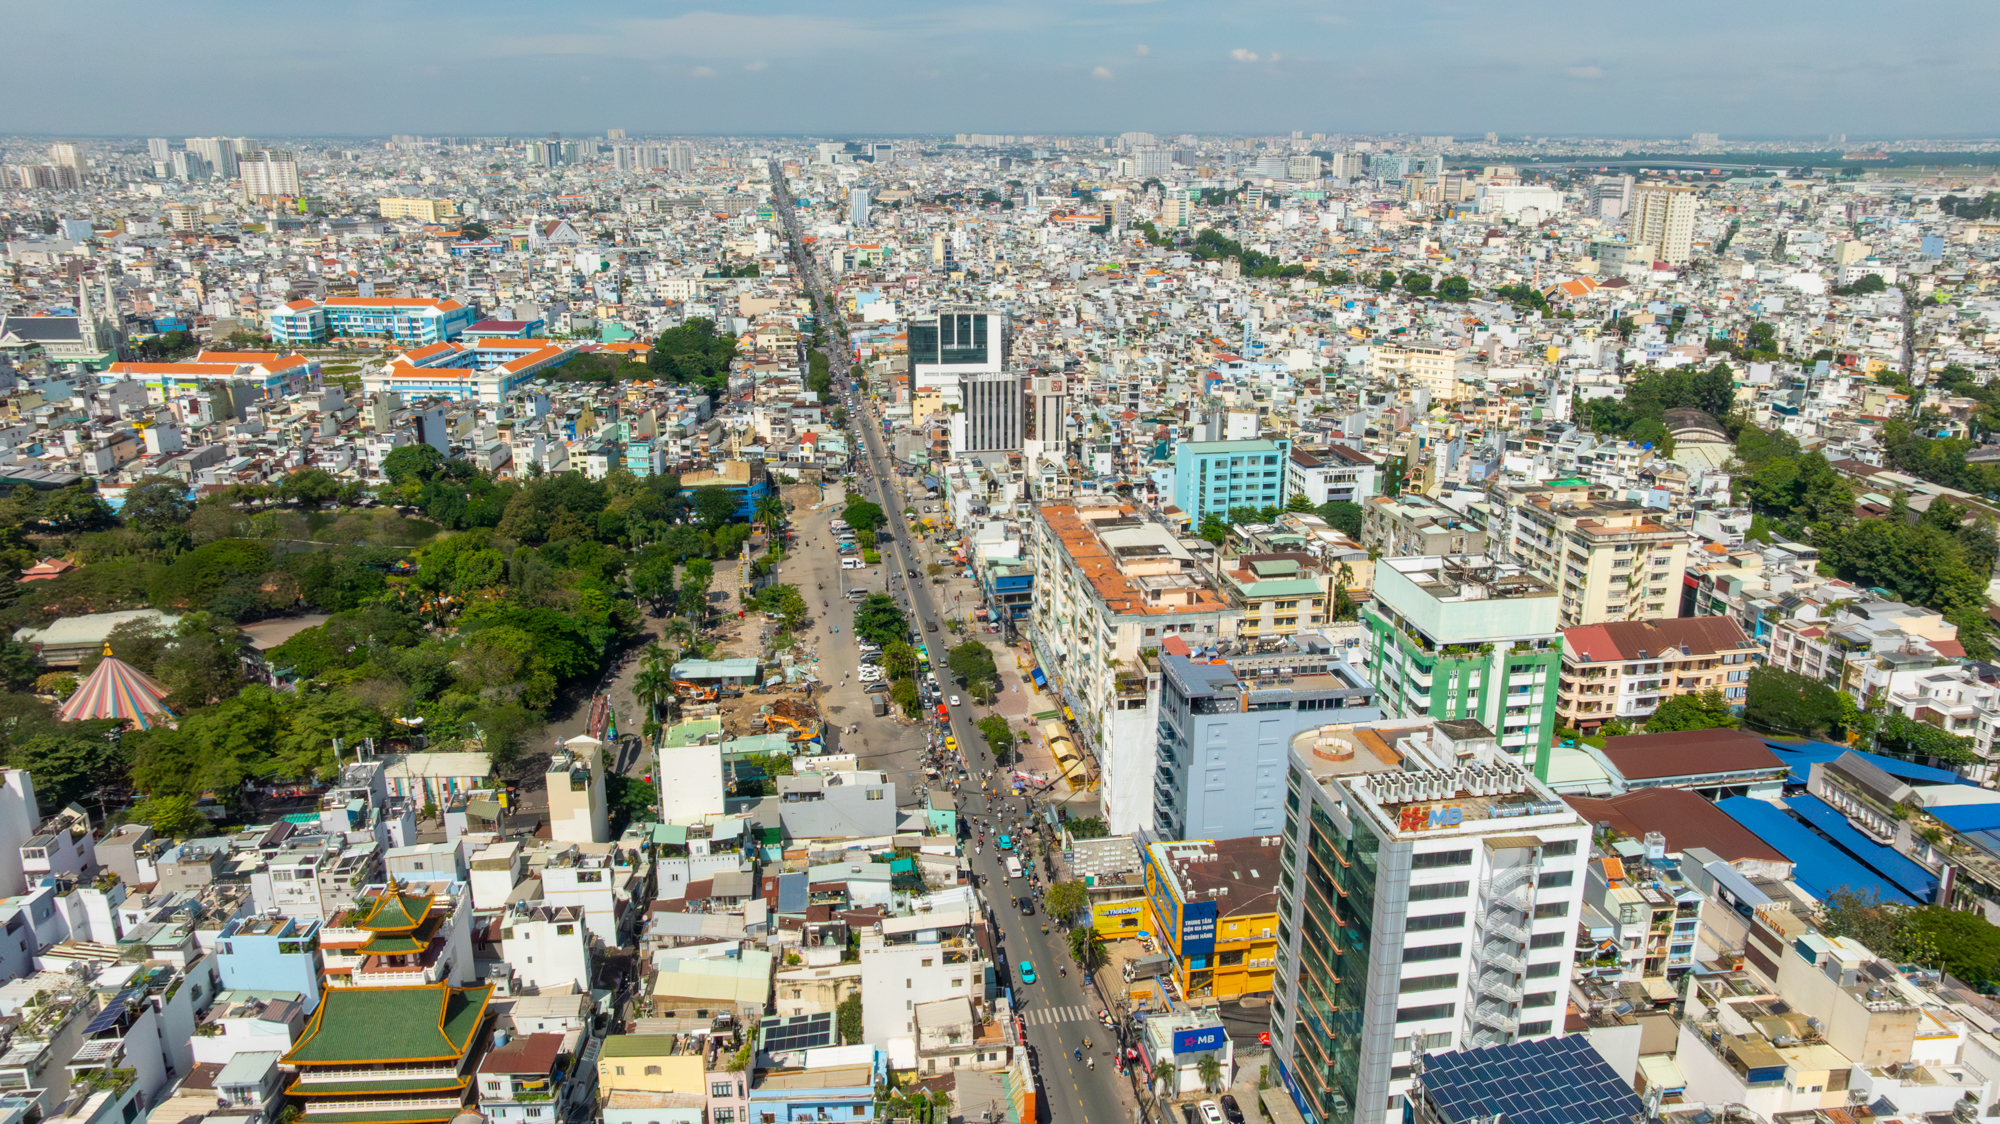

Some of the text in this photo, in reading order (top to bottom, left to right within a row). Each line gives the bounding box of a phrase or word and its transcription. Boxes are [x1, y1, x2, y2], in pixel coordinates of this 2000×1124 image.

[977, 372, 1013, 381] viettien
[1428, 807, 1462, 827] MB
[1770, 919, 1785, 937] STAR
[1197, 1034, 1215, 1045] MB
